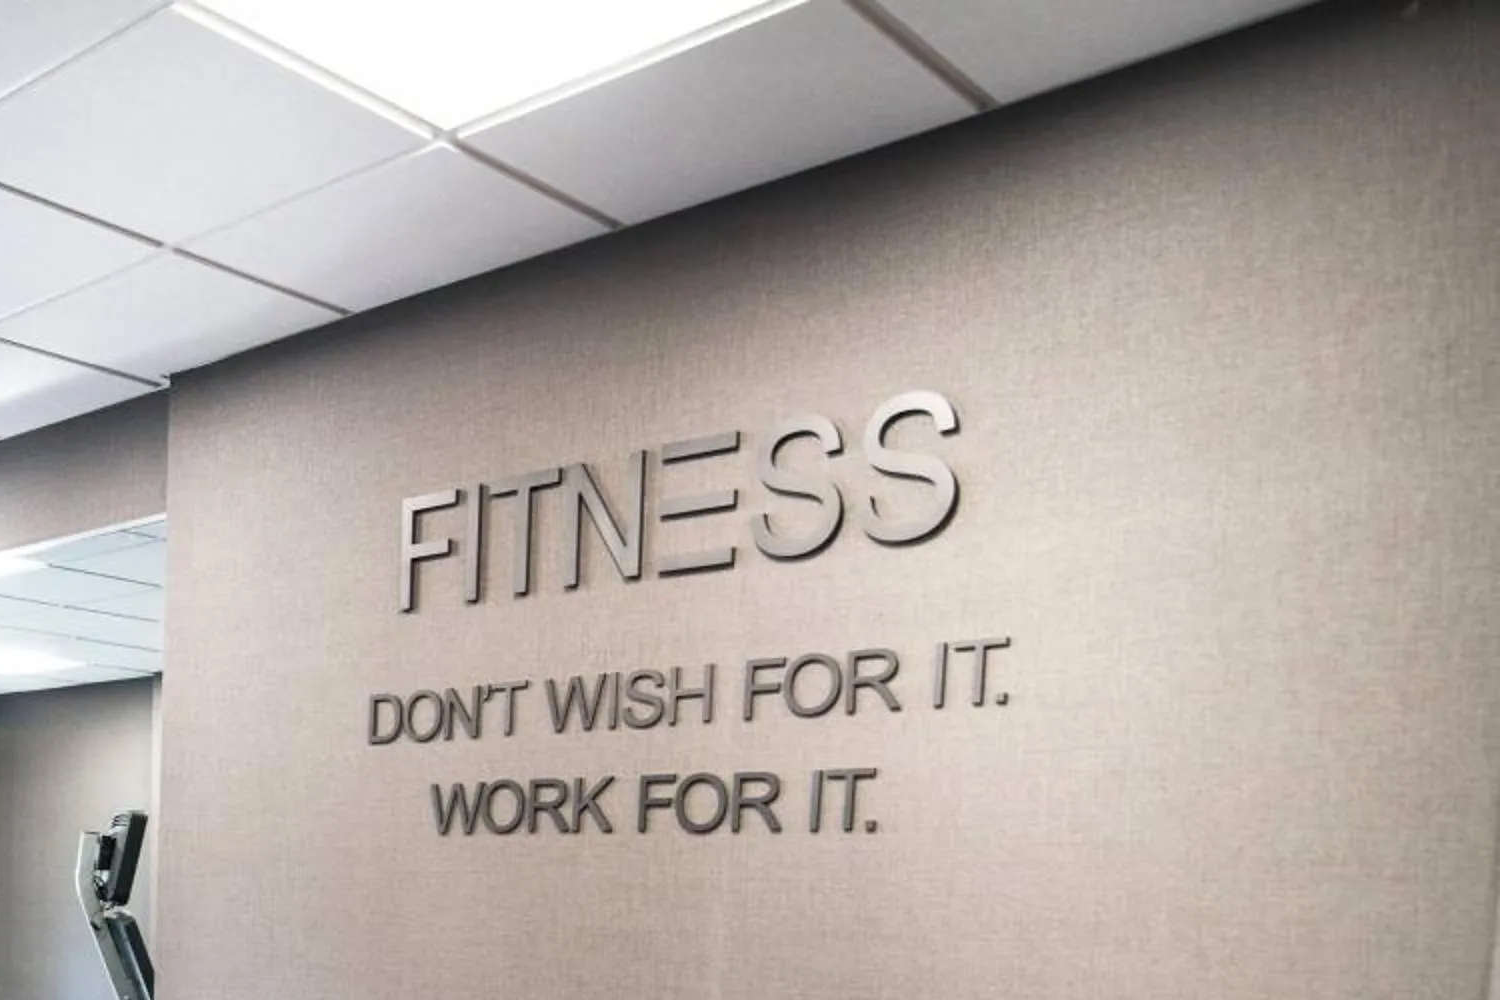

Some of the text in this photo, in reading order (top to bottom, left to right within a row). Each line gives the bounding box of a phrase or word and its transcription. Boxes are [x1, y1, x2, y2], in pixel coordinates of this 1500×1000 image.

[400, 389, 960, 613] FITNESS
[367, 635, 1012, 745] DON'T WISH FOR IT.
[431, 767, 879, 836] WORK FOR IT.
